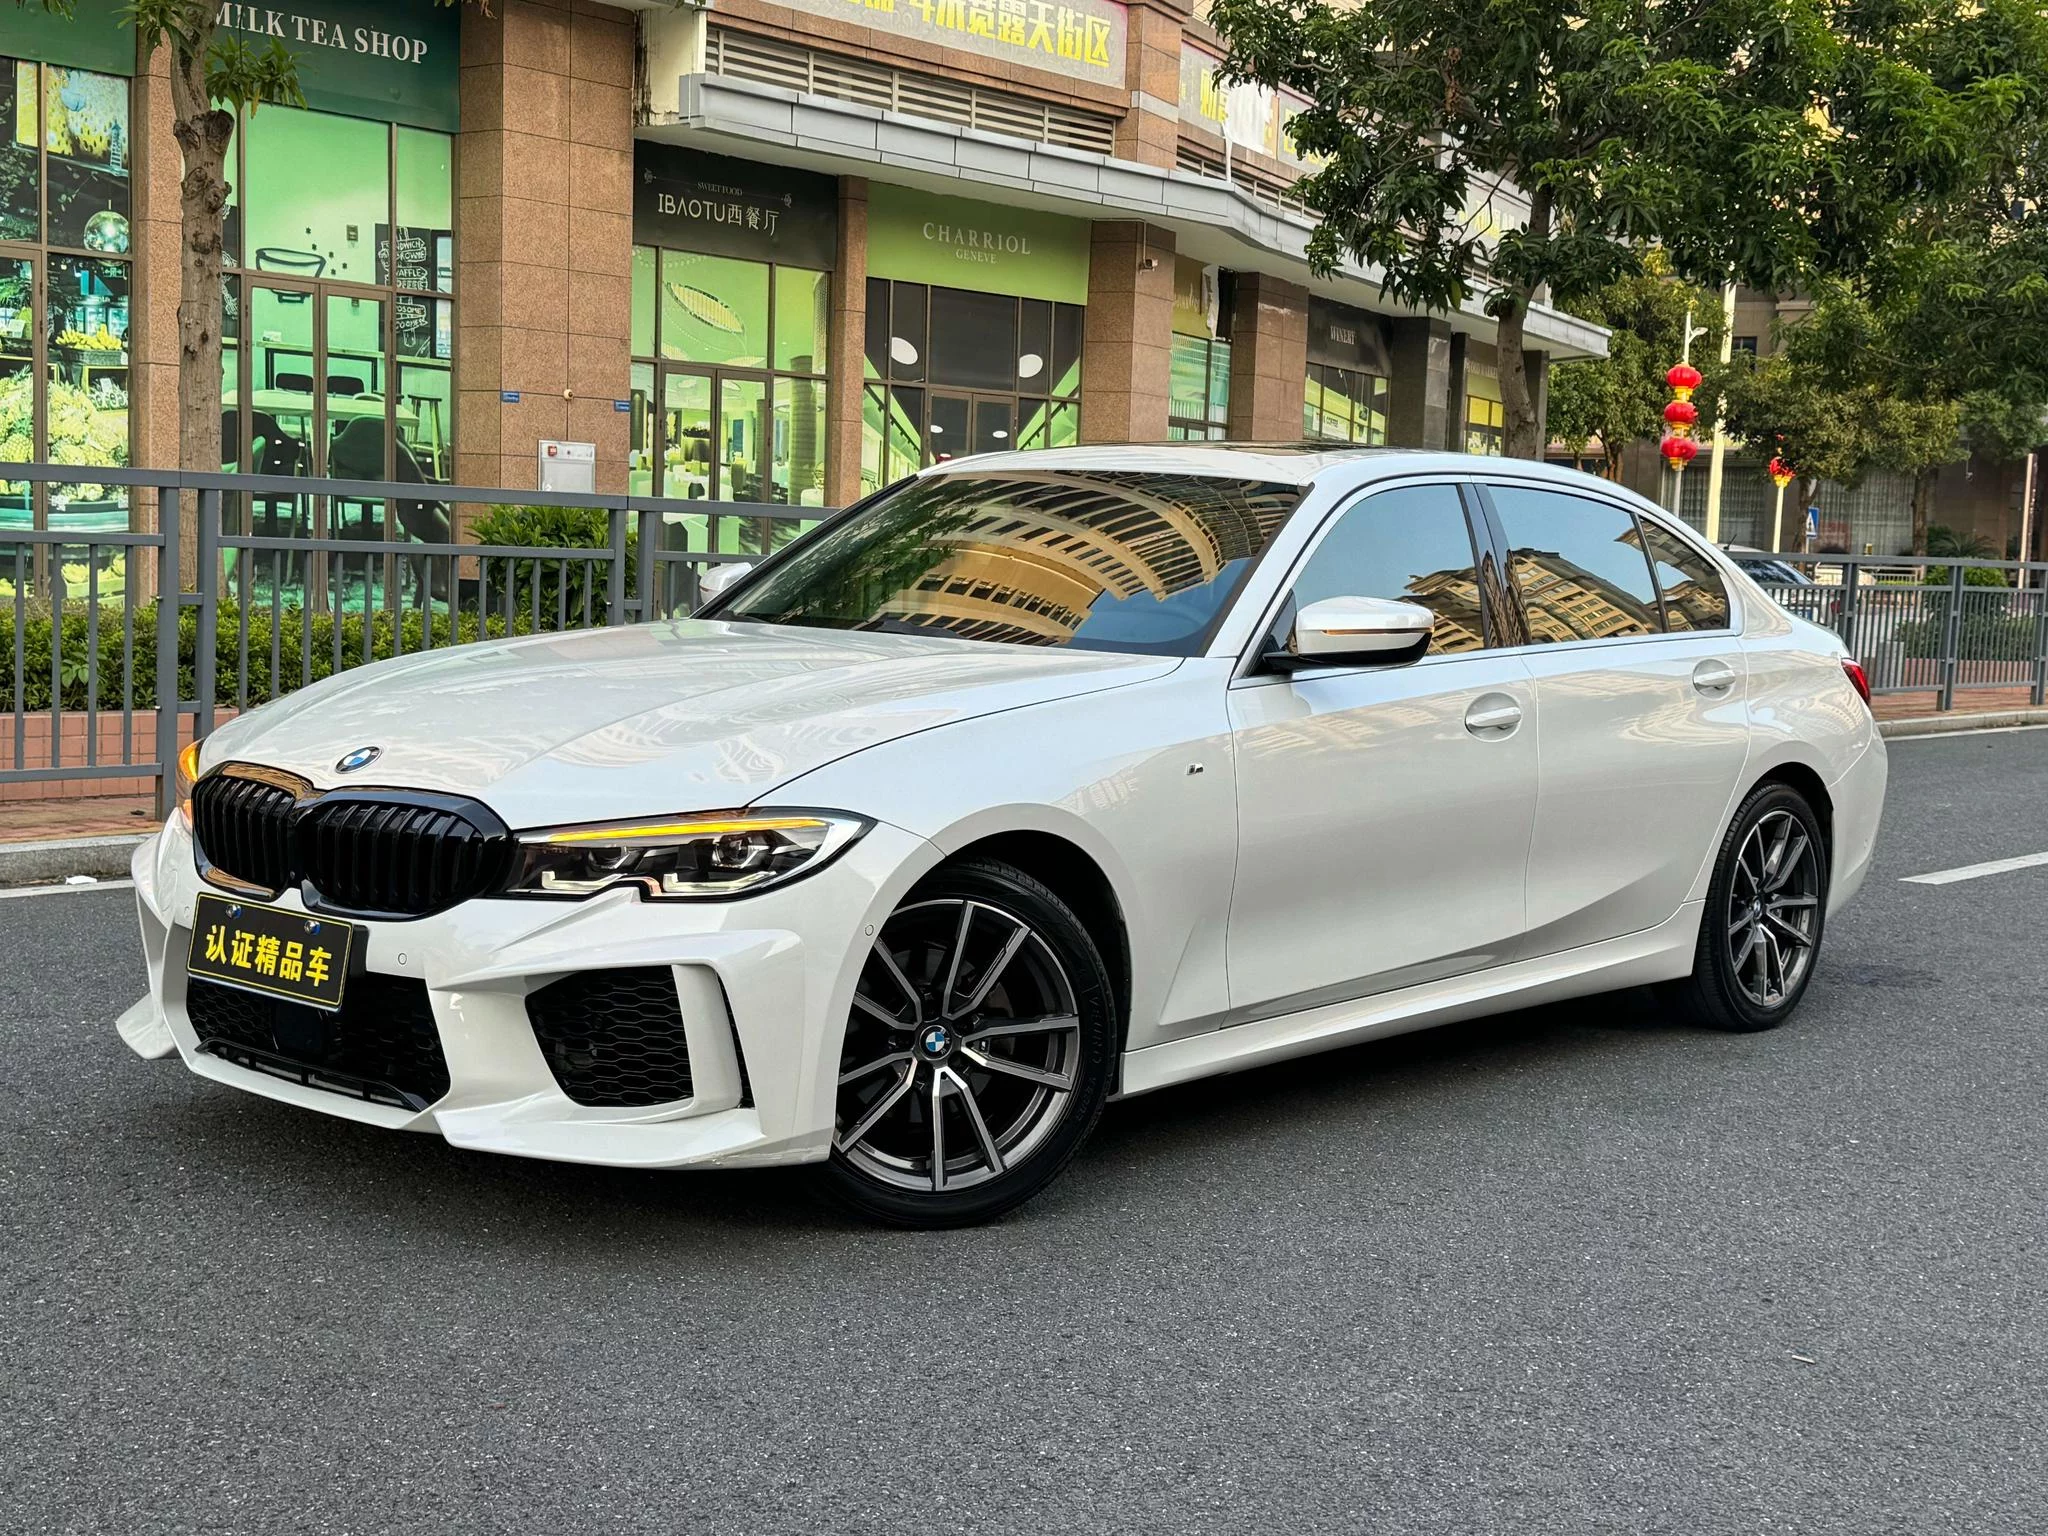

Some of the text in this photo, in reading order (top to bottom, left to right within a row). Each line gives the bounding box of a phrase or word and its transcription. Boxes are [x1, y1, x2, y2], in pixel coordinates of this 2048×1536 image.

[215, 1, 428, 64] MILK TEA SHOP
[697, 181, 743, 196] SWEET FOOD
[923, 222, 1031, 255] CHARRIOL
[956, 248, 997, 264] GENEVE
[396, 268, 422, 277] AFFLE
[205, 924, 332, 987] 认证精品车
